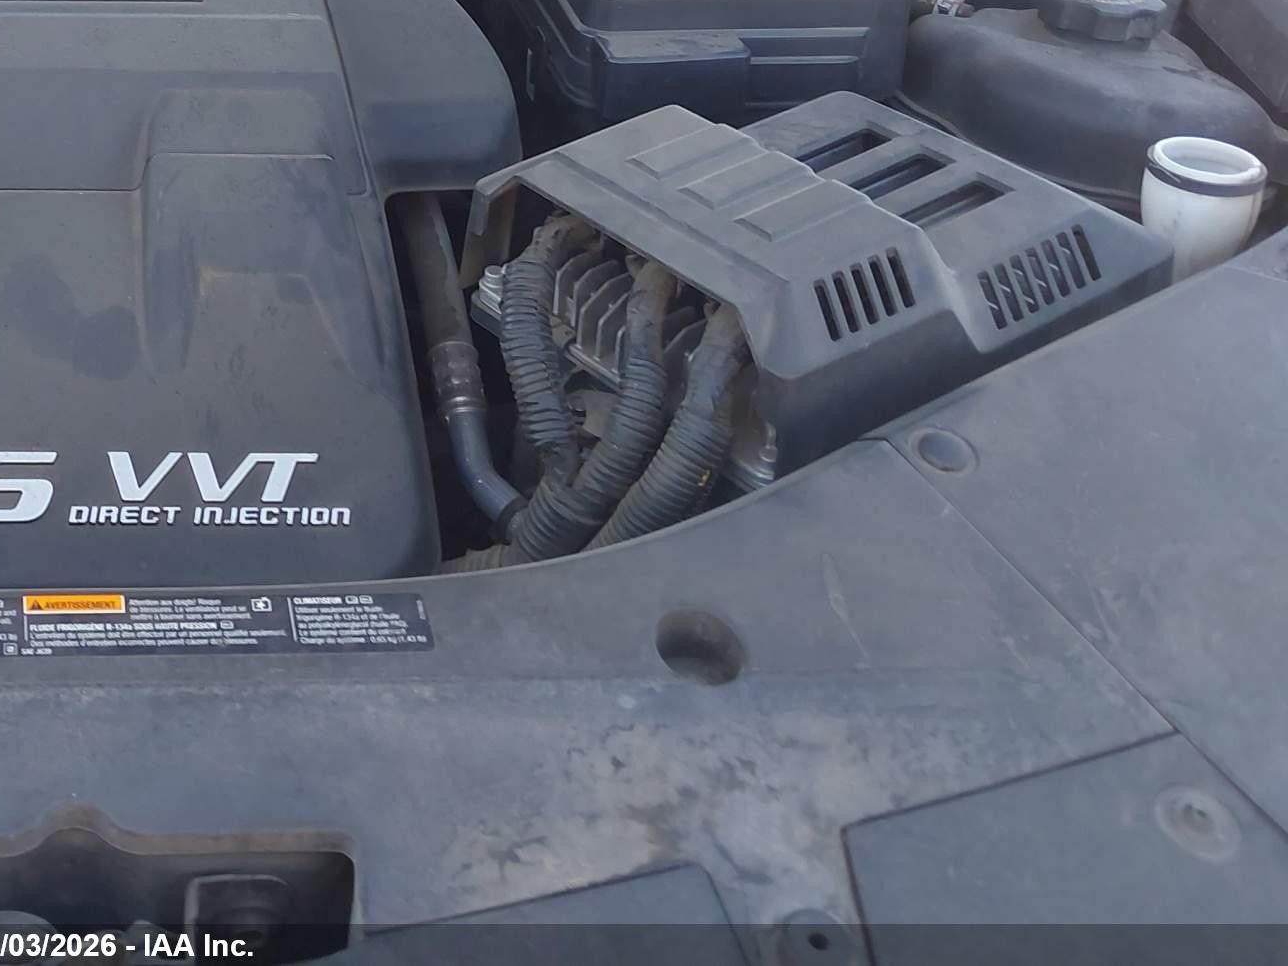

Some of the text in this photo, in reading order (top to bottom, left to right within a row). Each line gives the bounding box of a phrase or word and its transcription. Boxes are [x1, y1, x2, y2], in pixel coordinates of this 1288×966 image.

[107, 451, 319, 502] VVT
[69, 506, 351, 526] DIRECT INJECTION
[44, 601, 115, 610] AVERTISSEMENT
